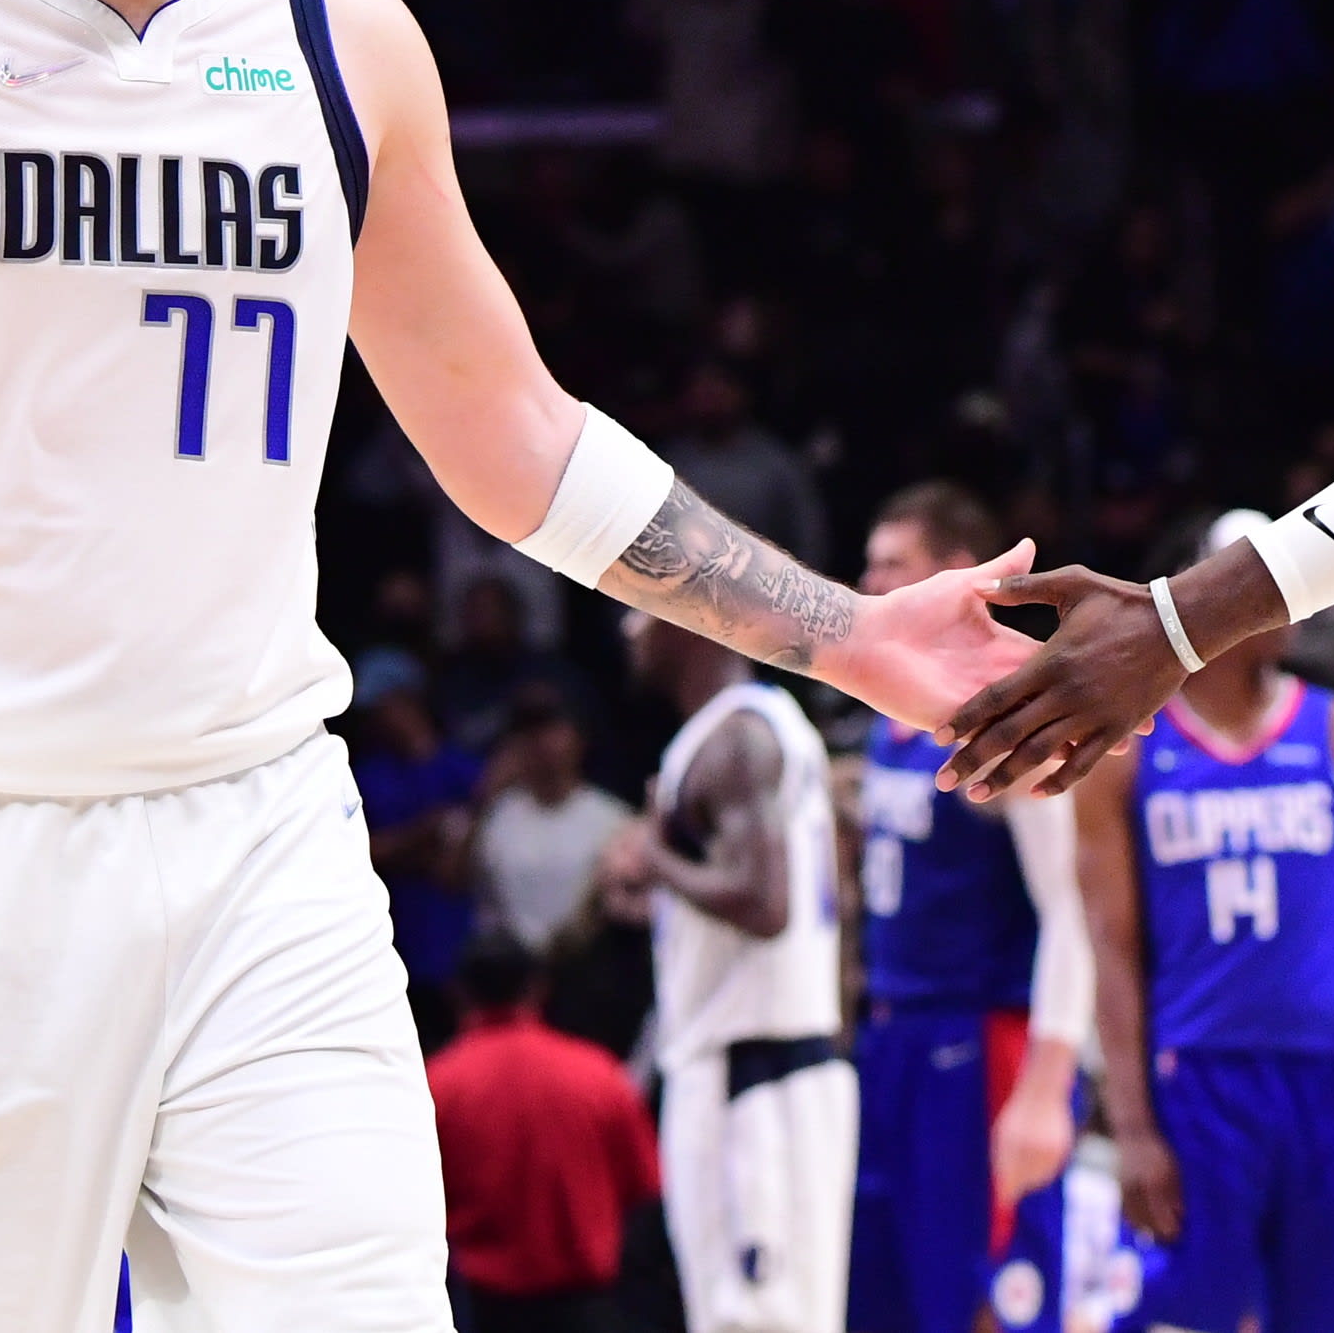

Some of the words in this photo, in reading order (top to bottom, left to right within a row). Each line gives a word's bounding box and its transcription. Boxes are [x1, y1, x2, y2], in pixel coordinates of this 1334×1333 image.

[205, 57, 296, 92] chime
[139, 289, 298, 467] 77
[1207, 856, 1279, 945] 14
